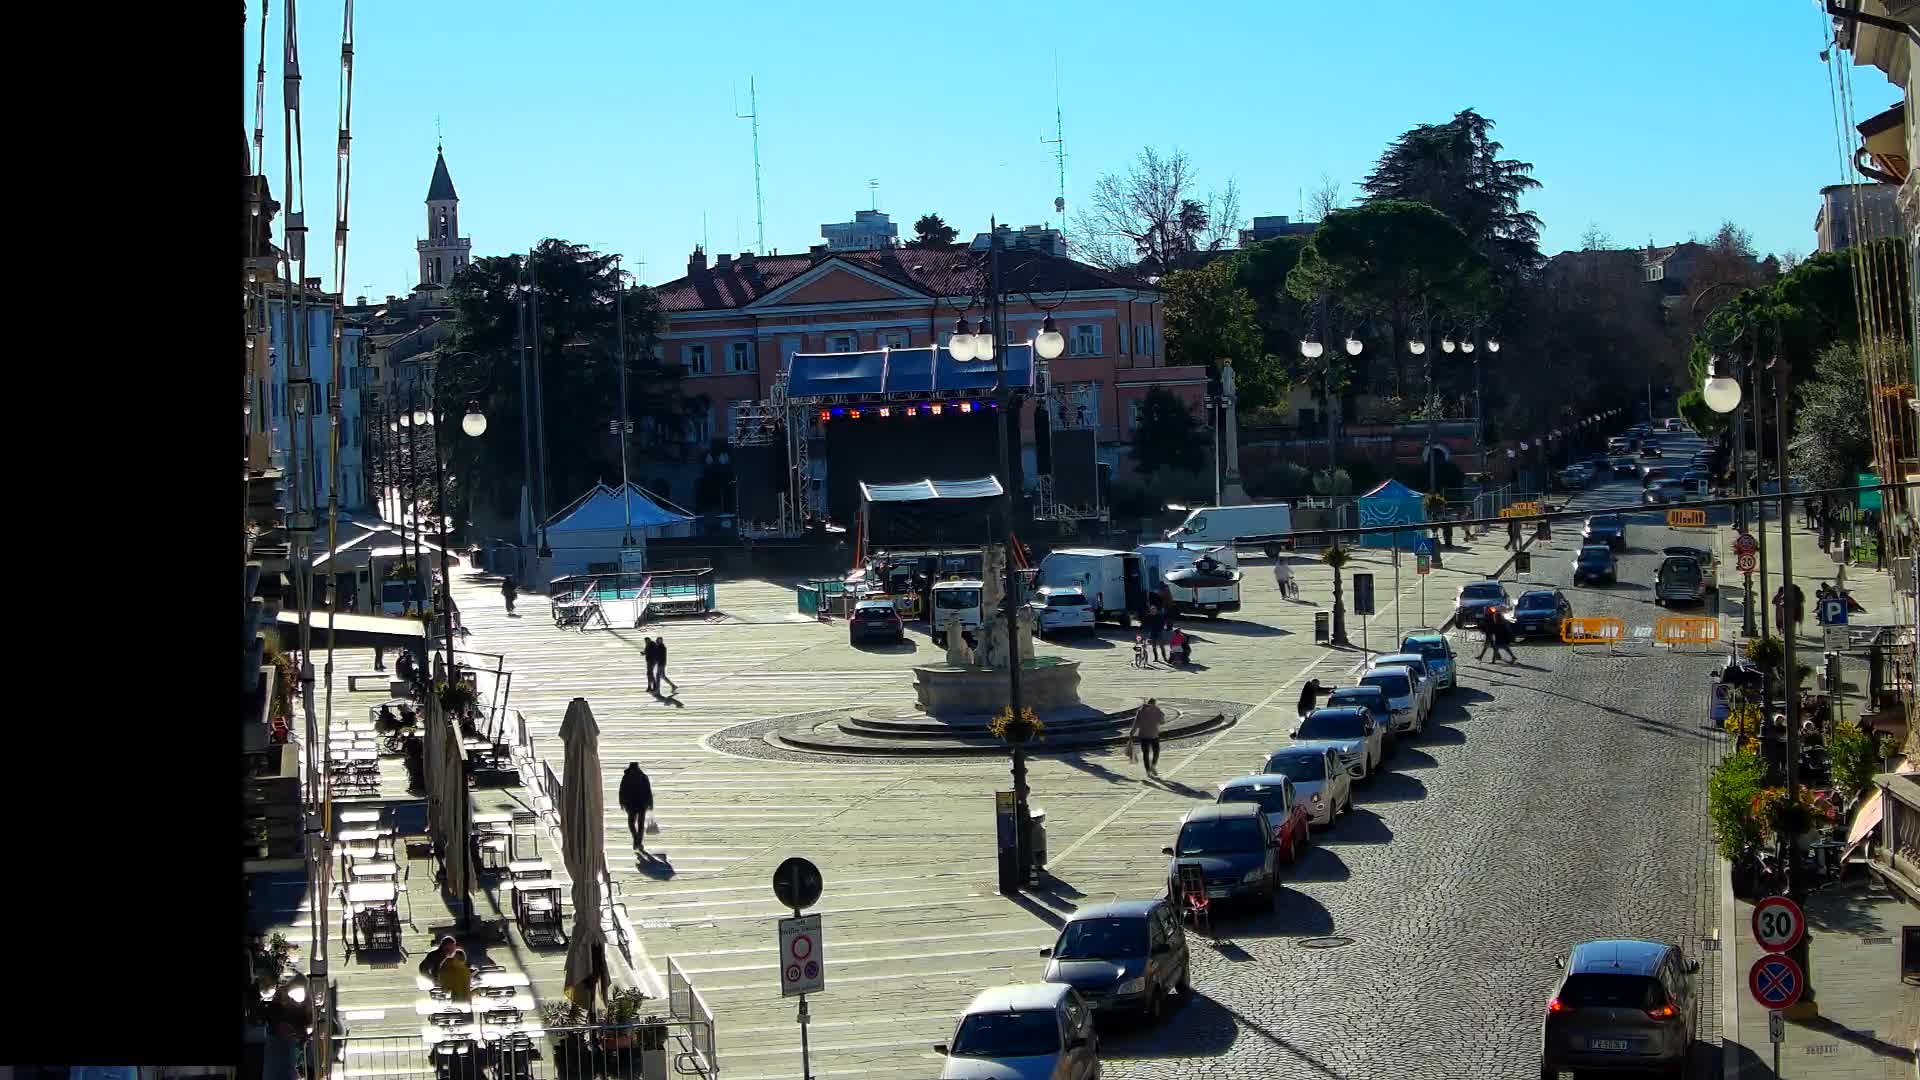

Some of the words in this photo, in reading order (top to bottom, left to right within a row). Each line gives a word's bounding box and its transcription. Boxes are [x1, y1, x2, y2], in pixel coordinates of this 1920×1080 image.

[1742, 557, 1753, 567] 20
[1827, 602, 1841, 622] P
[1762, 911, 1792, 938] 30
